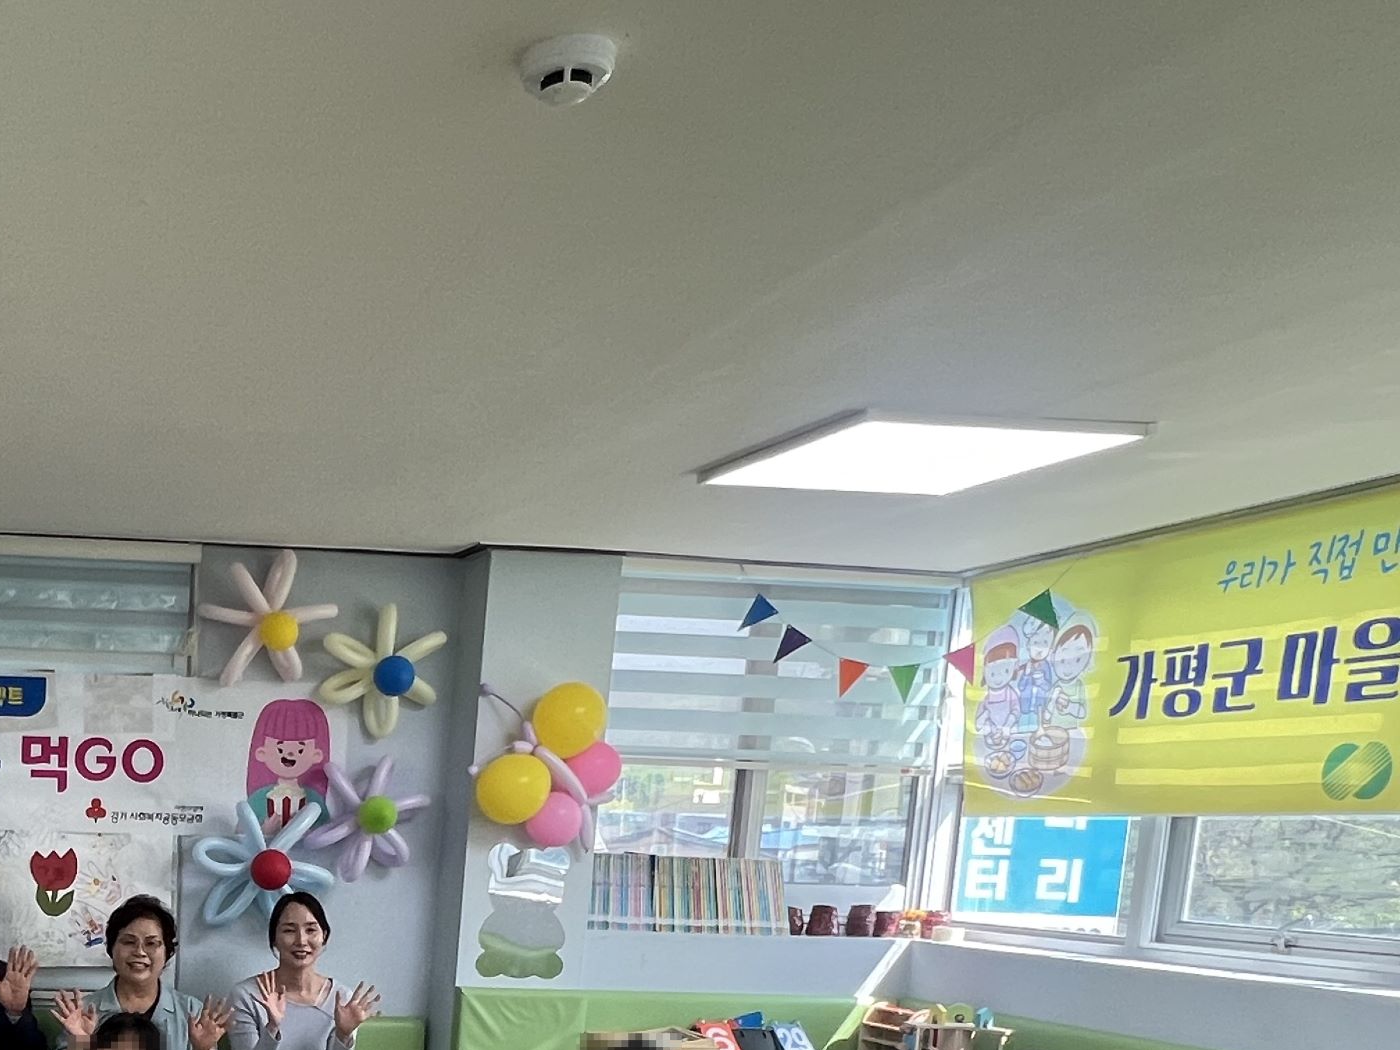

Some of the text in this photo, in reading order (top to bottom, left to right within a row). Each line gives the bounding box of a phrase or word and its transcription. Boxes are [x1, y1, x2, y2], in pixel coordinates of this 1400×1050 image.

[1217, 549, 1297, 593] 우리가
[1308, 529, 1364, 584] 직접
[1109, 616, 1400, 720] 가평군 마을
[21, 735, 164, 792] 먹GO
